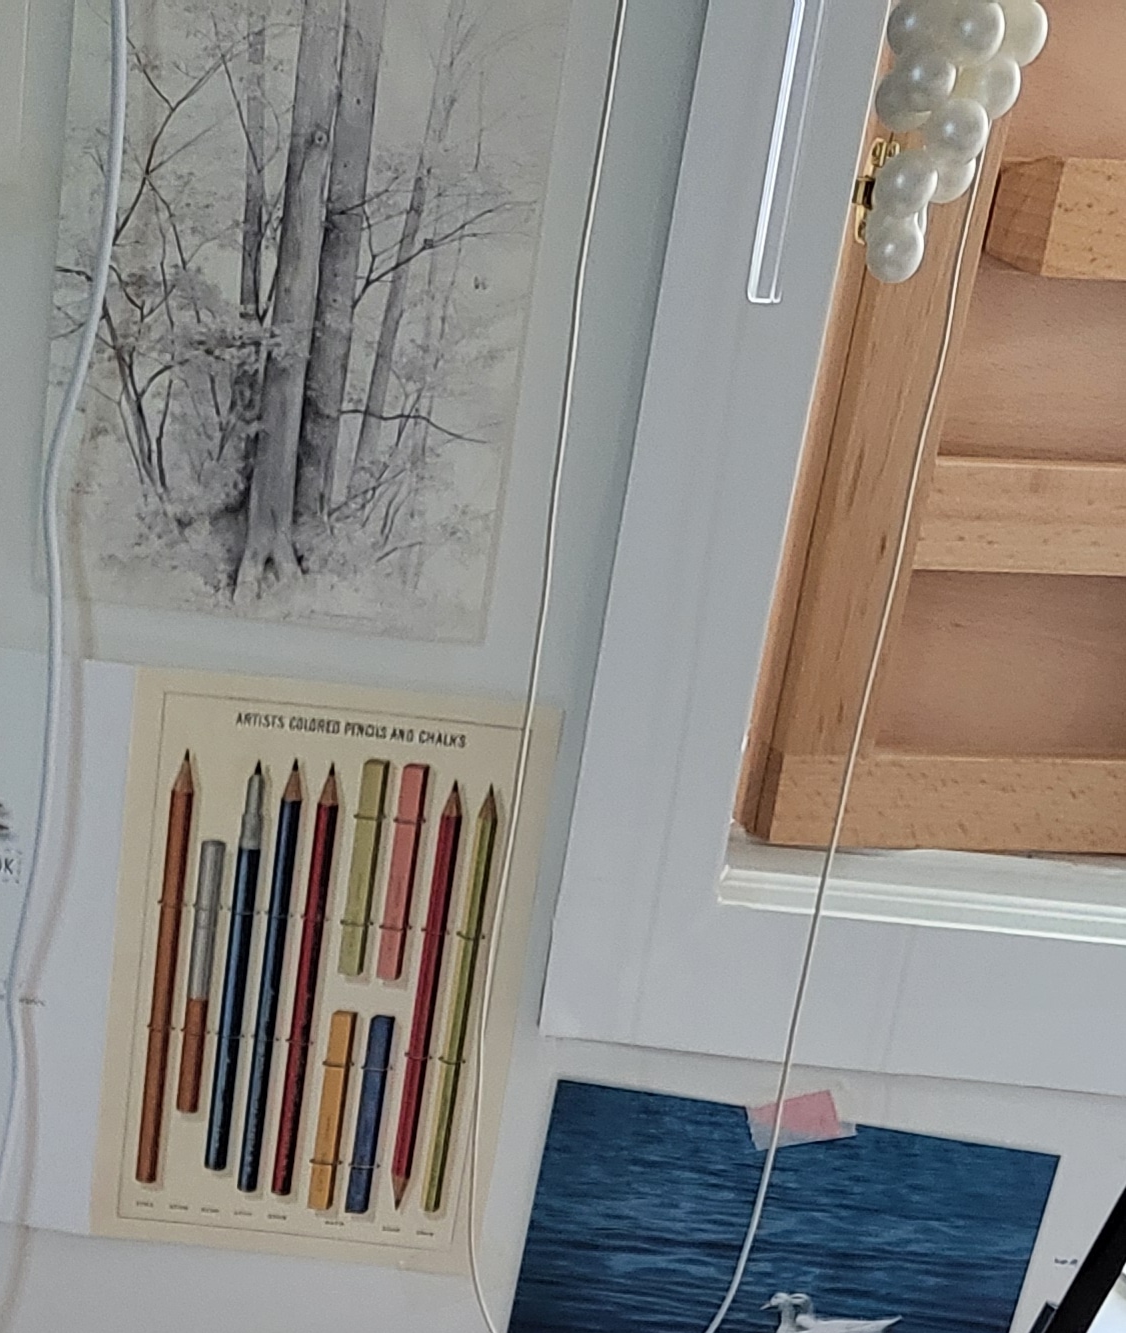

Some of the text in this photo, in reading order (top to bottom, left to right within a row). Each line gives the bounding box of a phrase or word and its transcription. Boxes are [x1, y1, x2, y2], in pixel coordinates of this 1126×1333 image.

[235, 711, 467, 749] ARTISTS COLORED PENCILS AND CHALKS
